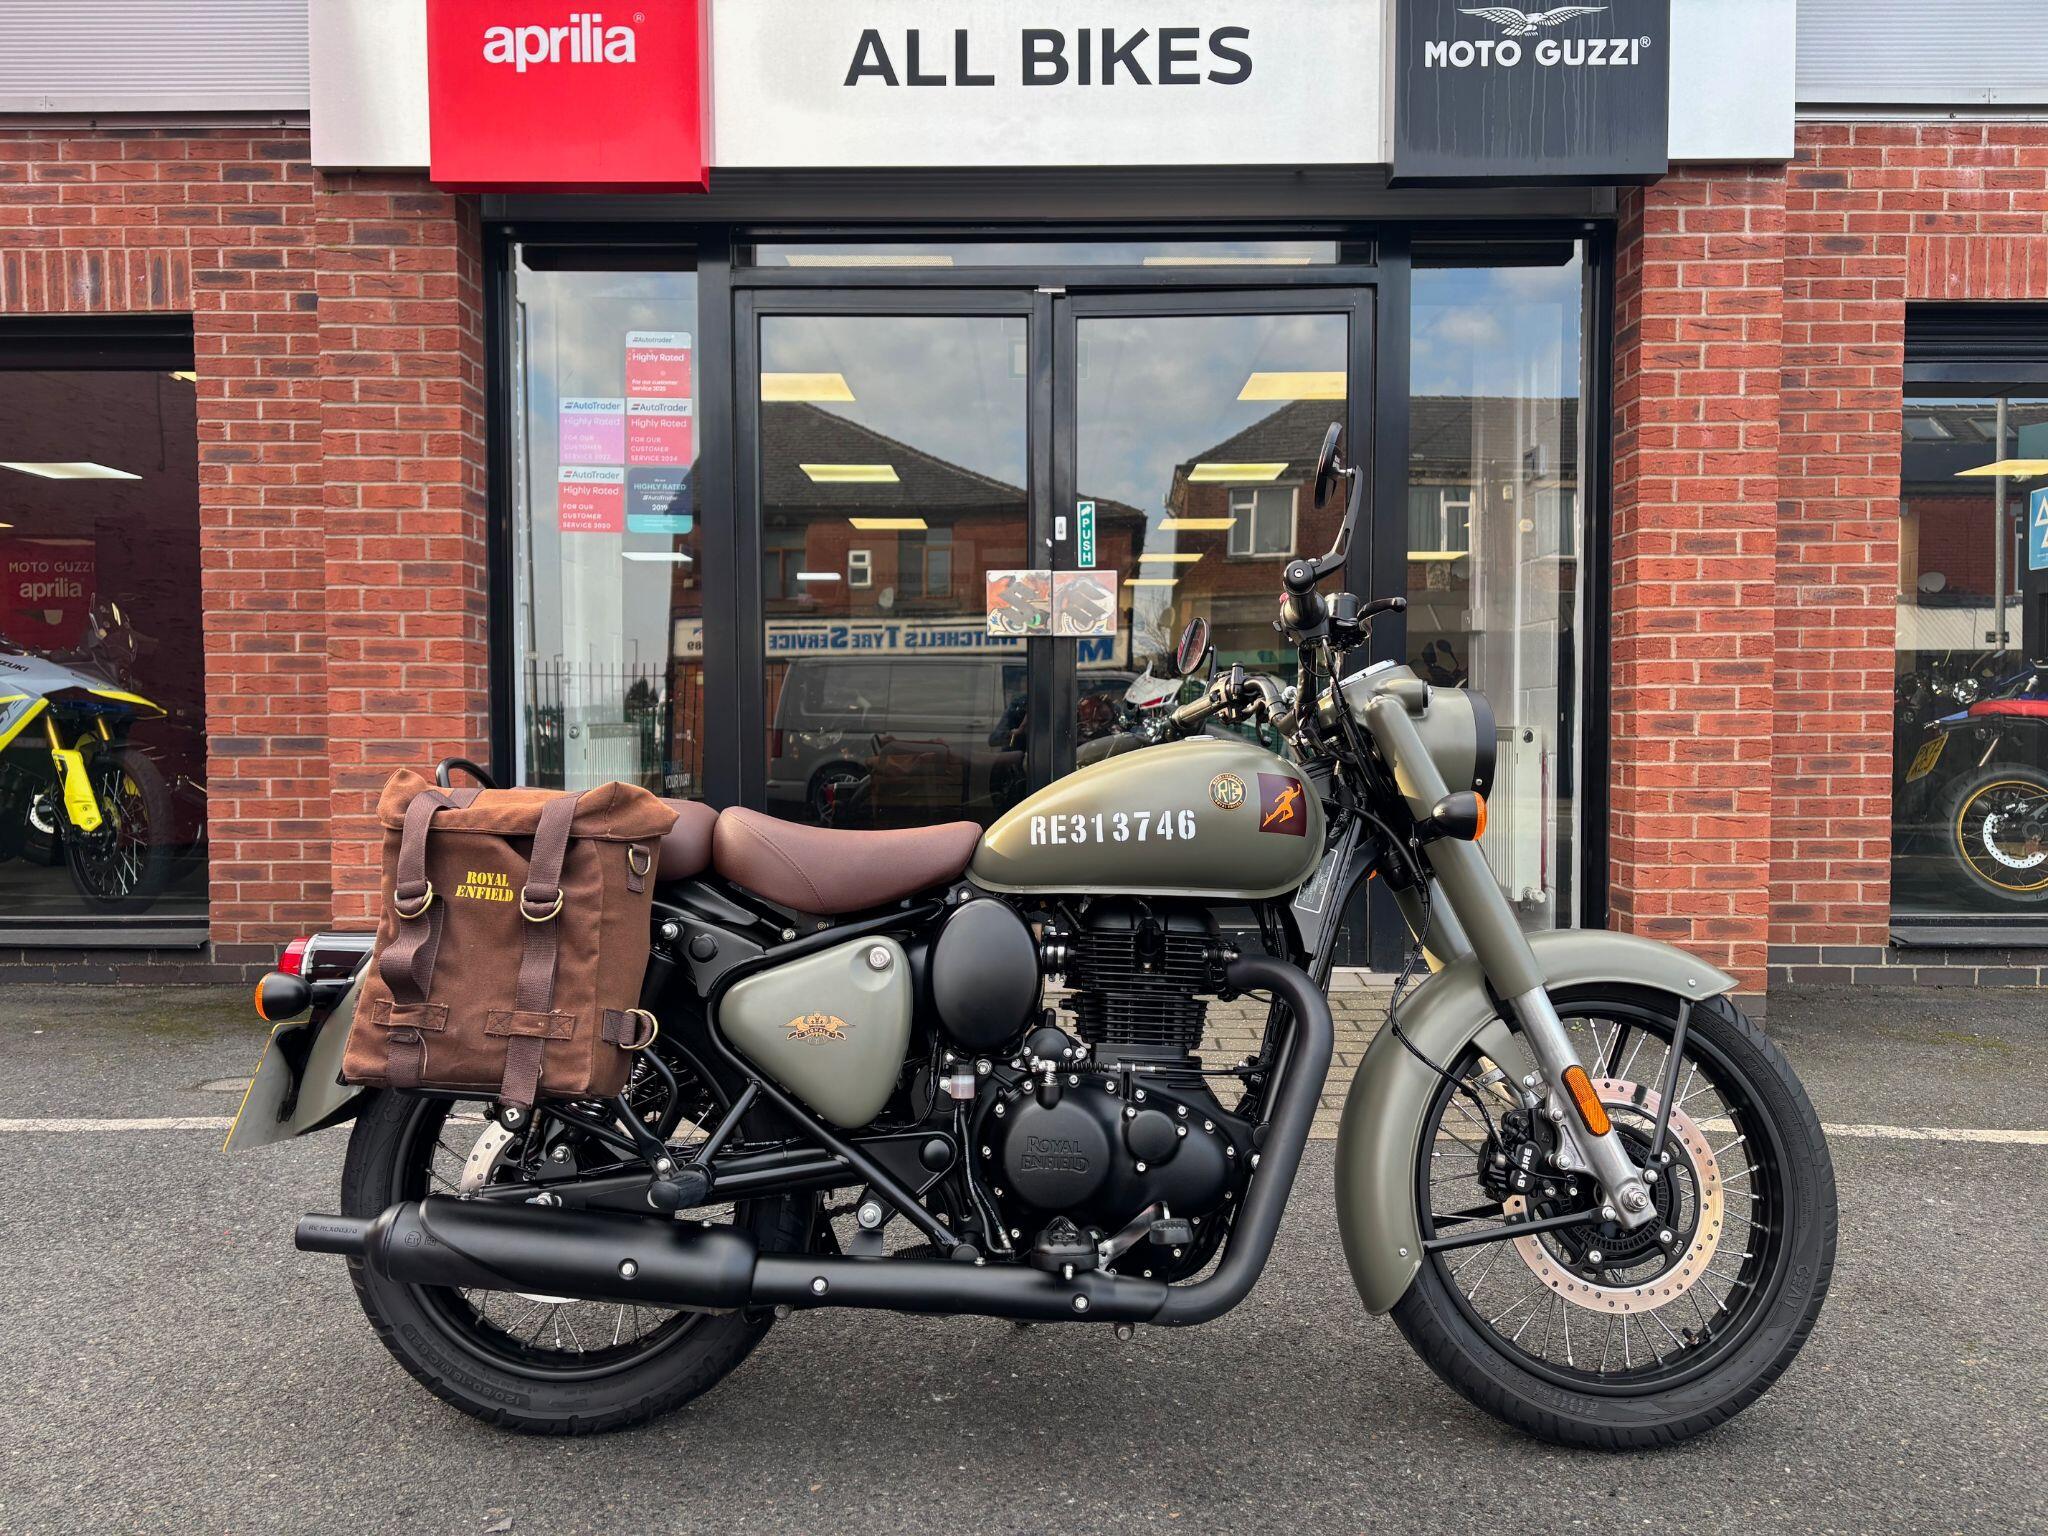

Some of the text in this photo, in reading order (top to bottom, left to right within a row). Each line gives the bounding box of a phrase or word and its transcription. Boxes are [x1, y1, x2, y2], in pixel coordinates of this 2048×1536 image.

[843, 26, 1254, 87] ALL BIKES
[1424, 39, 1523, 68] MOTO
[632, 352, 685, 363] Highly Rated
[573, 401, 621, 411] AutoTrader
[640, 402, 688, 412] AutoTrader
[564, 418, 621, 427] Highly Rated
[631, 419, 687, 428] Highly Rated
[572, 470, 620, 480] AutoTrader
[563, 485, 619, 496] Highly Rated
[634, 483, 687, 491] HIGHLY RATED
[1082, 518, 1092, 562] PUSH
[8, 561, 95, 573] MOTO GUZZI
[19, 577, 82, 601] aprilia
[1030, 809, 1197, 846] RE313746
[466, 870, 510, 887] ROYAL
[454, 884, 515, 902] ENFIELD
[1026, 1135, 1082, 1155] ROYAL
[1021, 1154, 1090, 1174] ENFIELD
